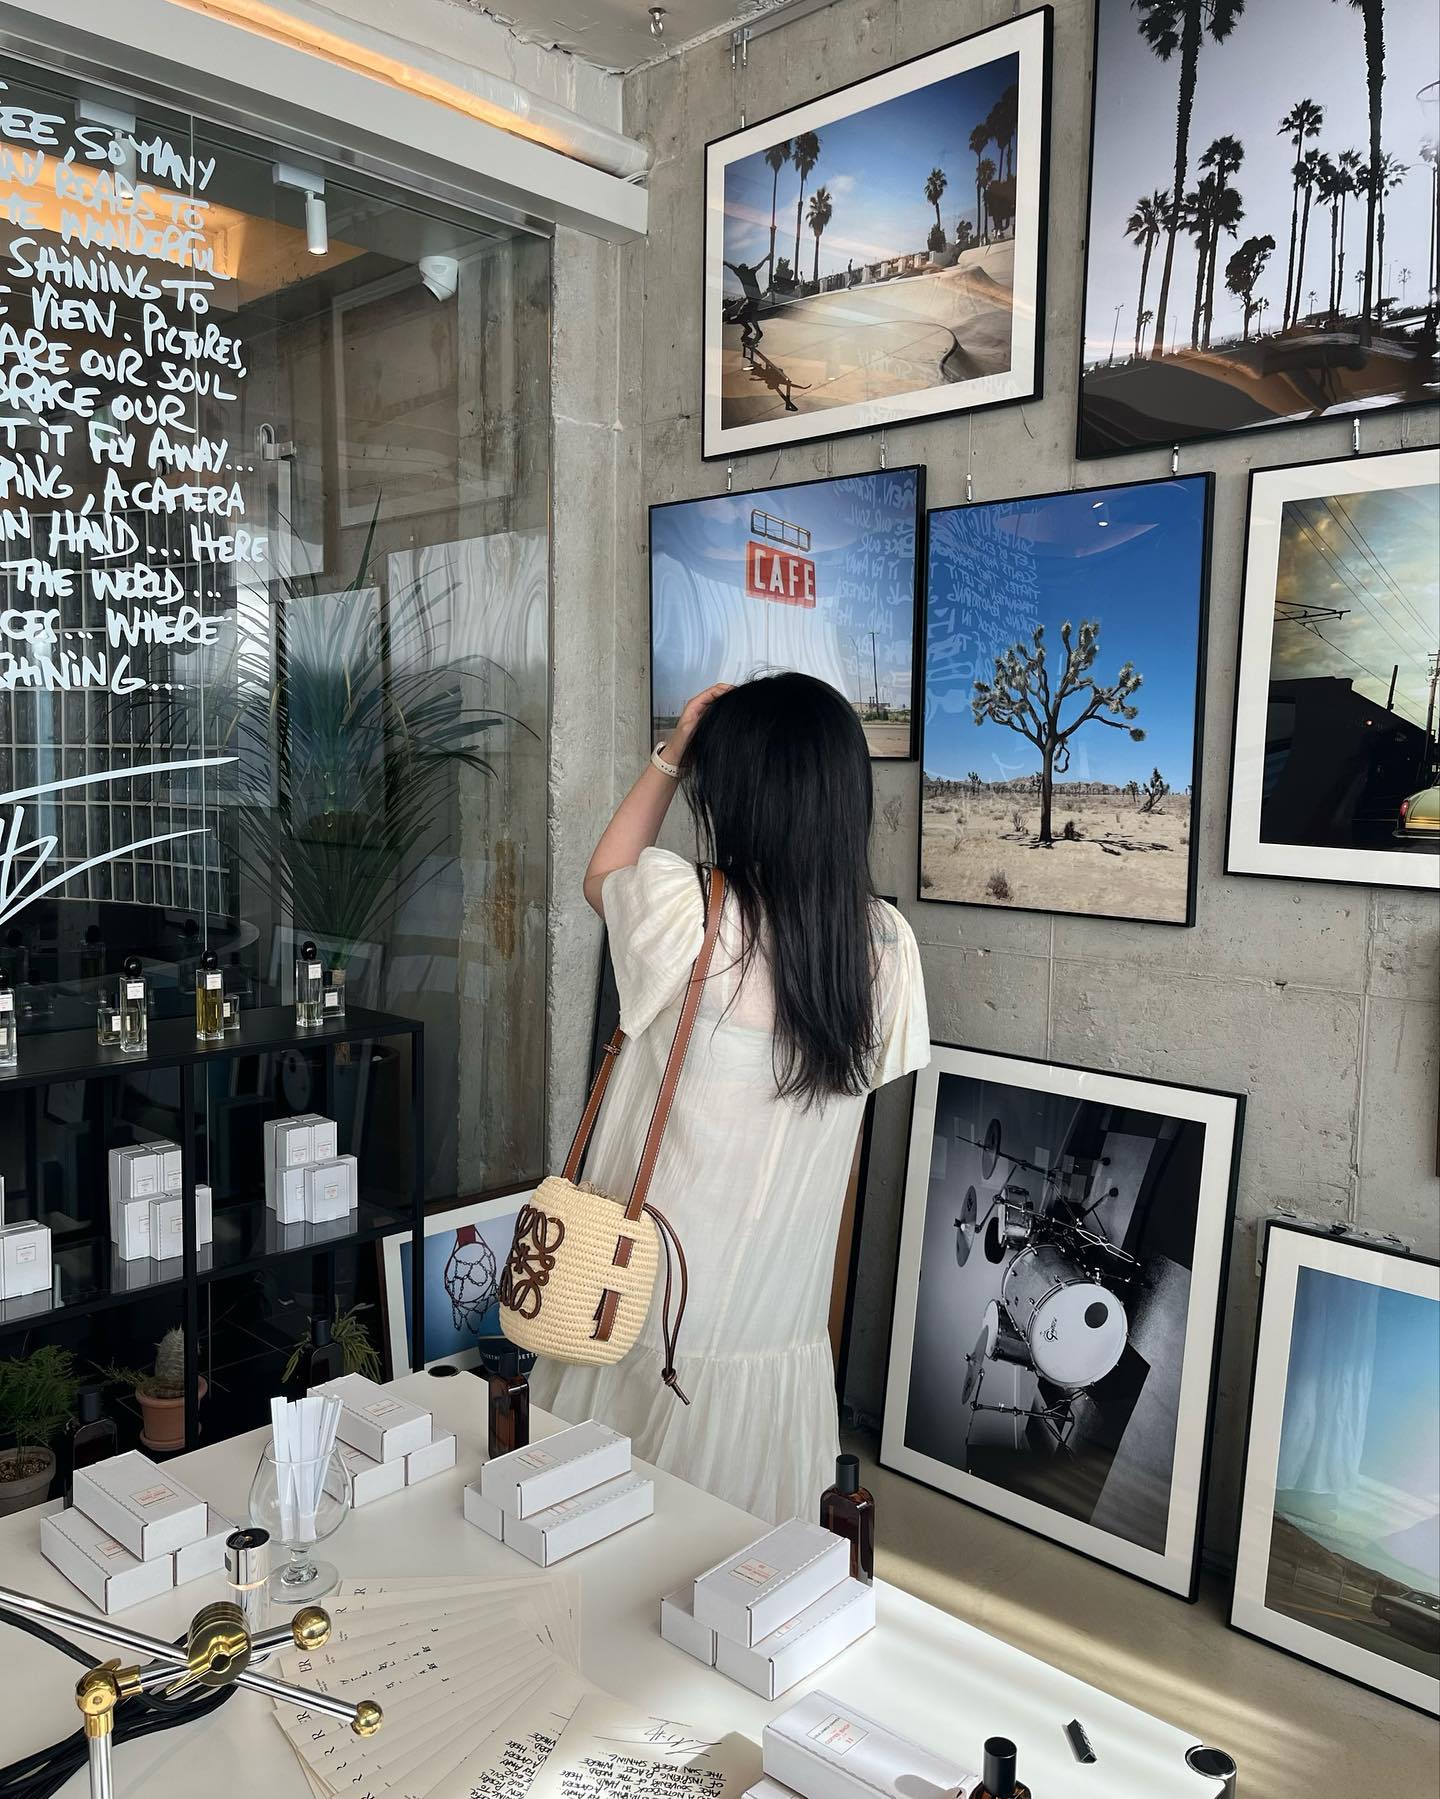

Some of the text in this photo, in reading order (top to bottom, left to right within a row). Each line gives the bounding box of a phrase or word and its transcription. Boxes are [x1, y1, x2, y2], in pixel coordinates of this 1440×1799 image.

[128, 134, 216, 191] MANY
[159, 194, 210, 230] TO
[161, 279, 215, 314] TO
[80, 347, 148, 387] OUR
[156, 360, 237, 401] SOUL
[111, 394, 197, 434] OUR
[88, 420, 136, 468] FLY
[190, 521, 269, 563] HERE
[0, 557, 75, 598] THE
[754, 548, 814, 601] CAFE
[106, 605, 232, 649] WHERE
[559, 1770, 583, 1781] HERE
